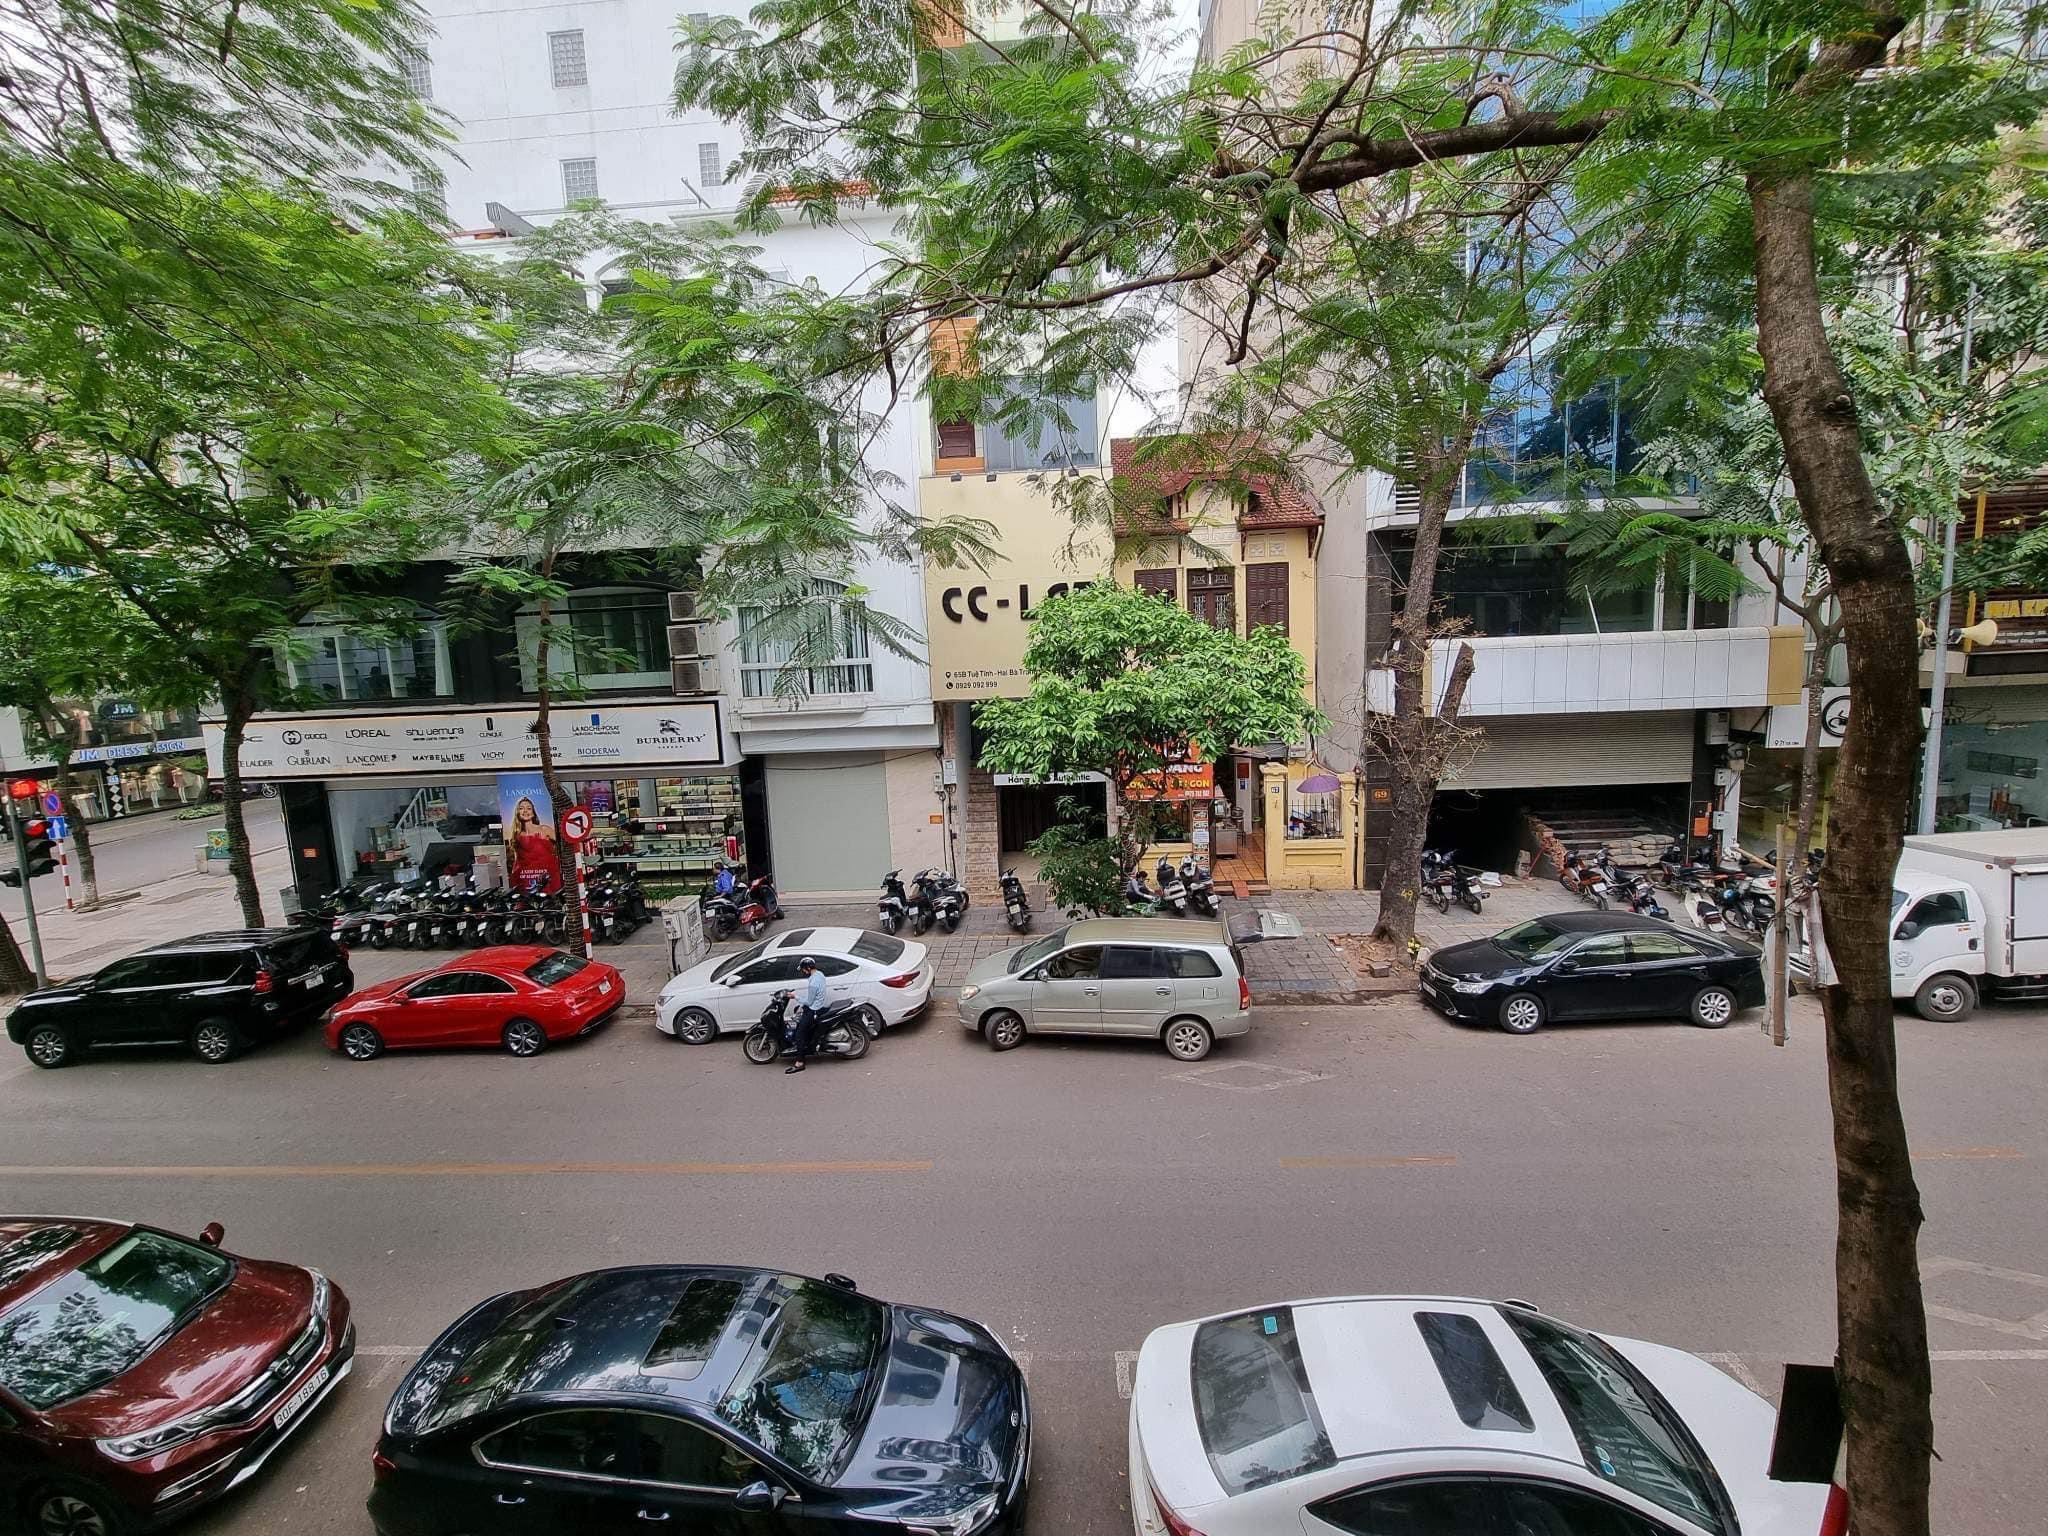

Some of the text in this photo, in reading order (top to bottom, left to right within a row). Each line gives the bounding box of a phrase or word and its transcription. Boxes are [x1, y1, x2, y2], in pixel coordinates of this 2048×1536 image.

[406, 727, 465, 737] shu uemura
[636, 736, 703, 745] BURBERRY
[79, 750, 99, 761] JM
[107, 745, 142, 758] DRESS
[481, 751, 505, 759] VICHY
[577, 747, 620, 755] BIODERMA
[286, 755, 331, 766] GUERLAIN
[412, 753, 465, 762] MAYBELLINE
[1374, 790, 1387, 799] 69
